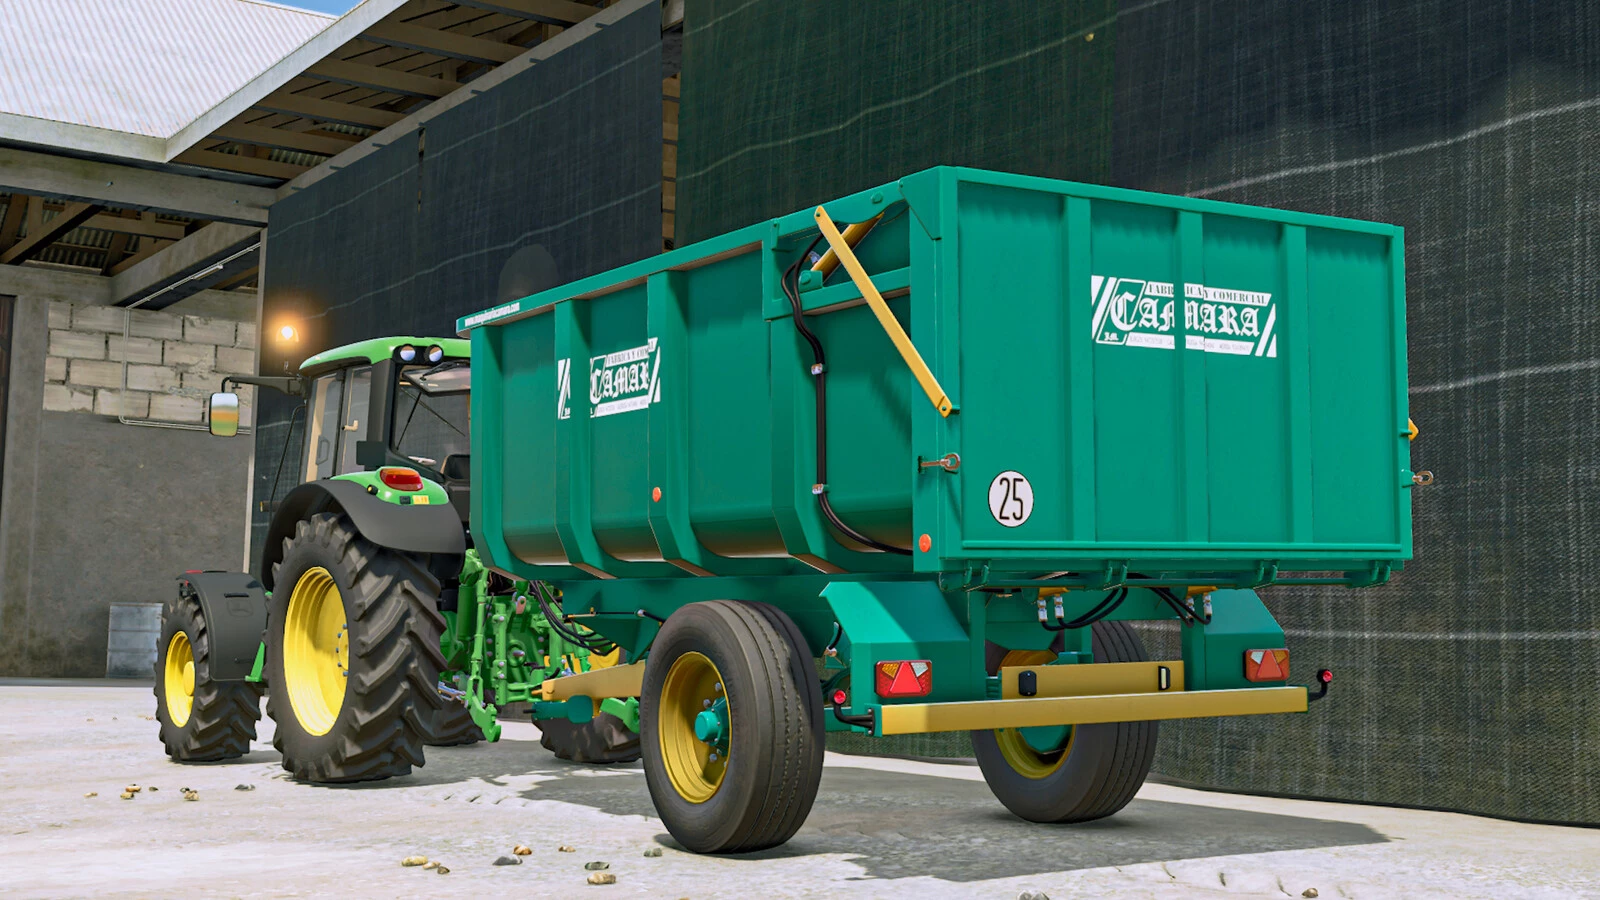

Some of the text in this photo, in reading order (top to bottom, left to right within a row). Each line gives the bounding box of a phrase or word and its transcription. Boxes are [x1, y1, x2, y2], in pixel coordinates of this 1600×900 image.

[1110, 291, 1260, 337] CAMARA
[1148, 284, 1267, 305] FABRICA Y COMERCIAL
[590, 361, 649, 404] CAMAR
[999, 477, 1024, 520] 25
